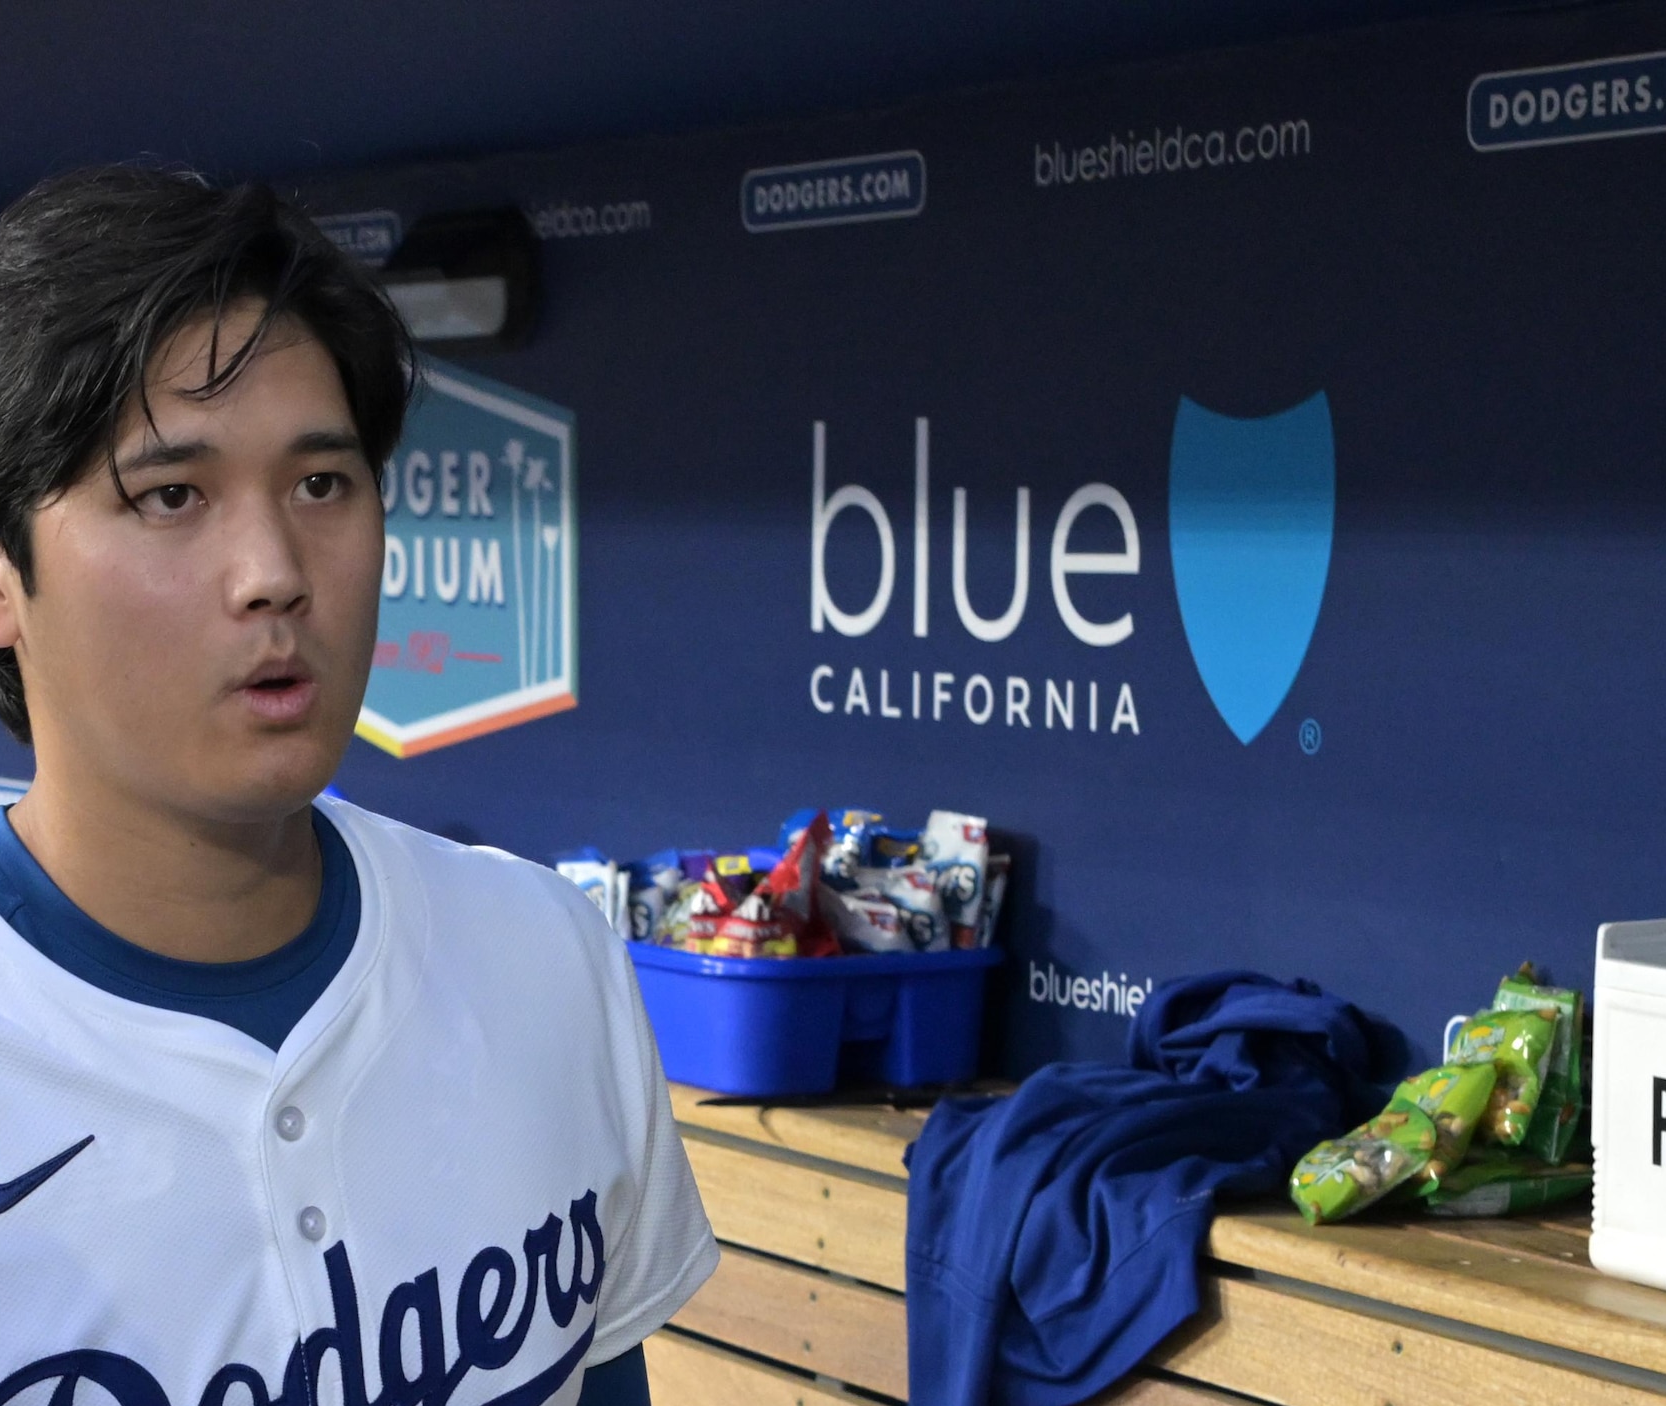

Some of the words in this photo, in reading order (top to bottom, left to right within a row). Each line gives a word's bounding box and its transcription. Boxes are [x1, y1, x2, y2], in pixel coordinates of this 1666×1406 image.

[1035, 117, 1311, 187] blueshieldca.com
[754, 168, 911, 215] DODGERS.COM
[810, 416, 1141, 647] blue
[810, 665, 1141, 736] CALIFORNIA
